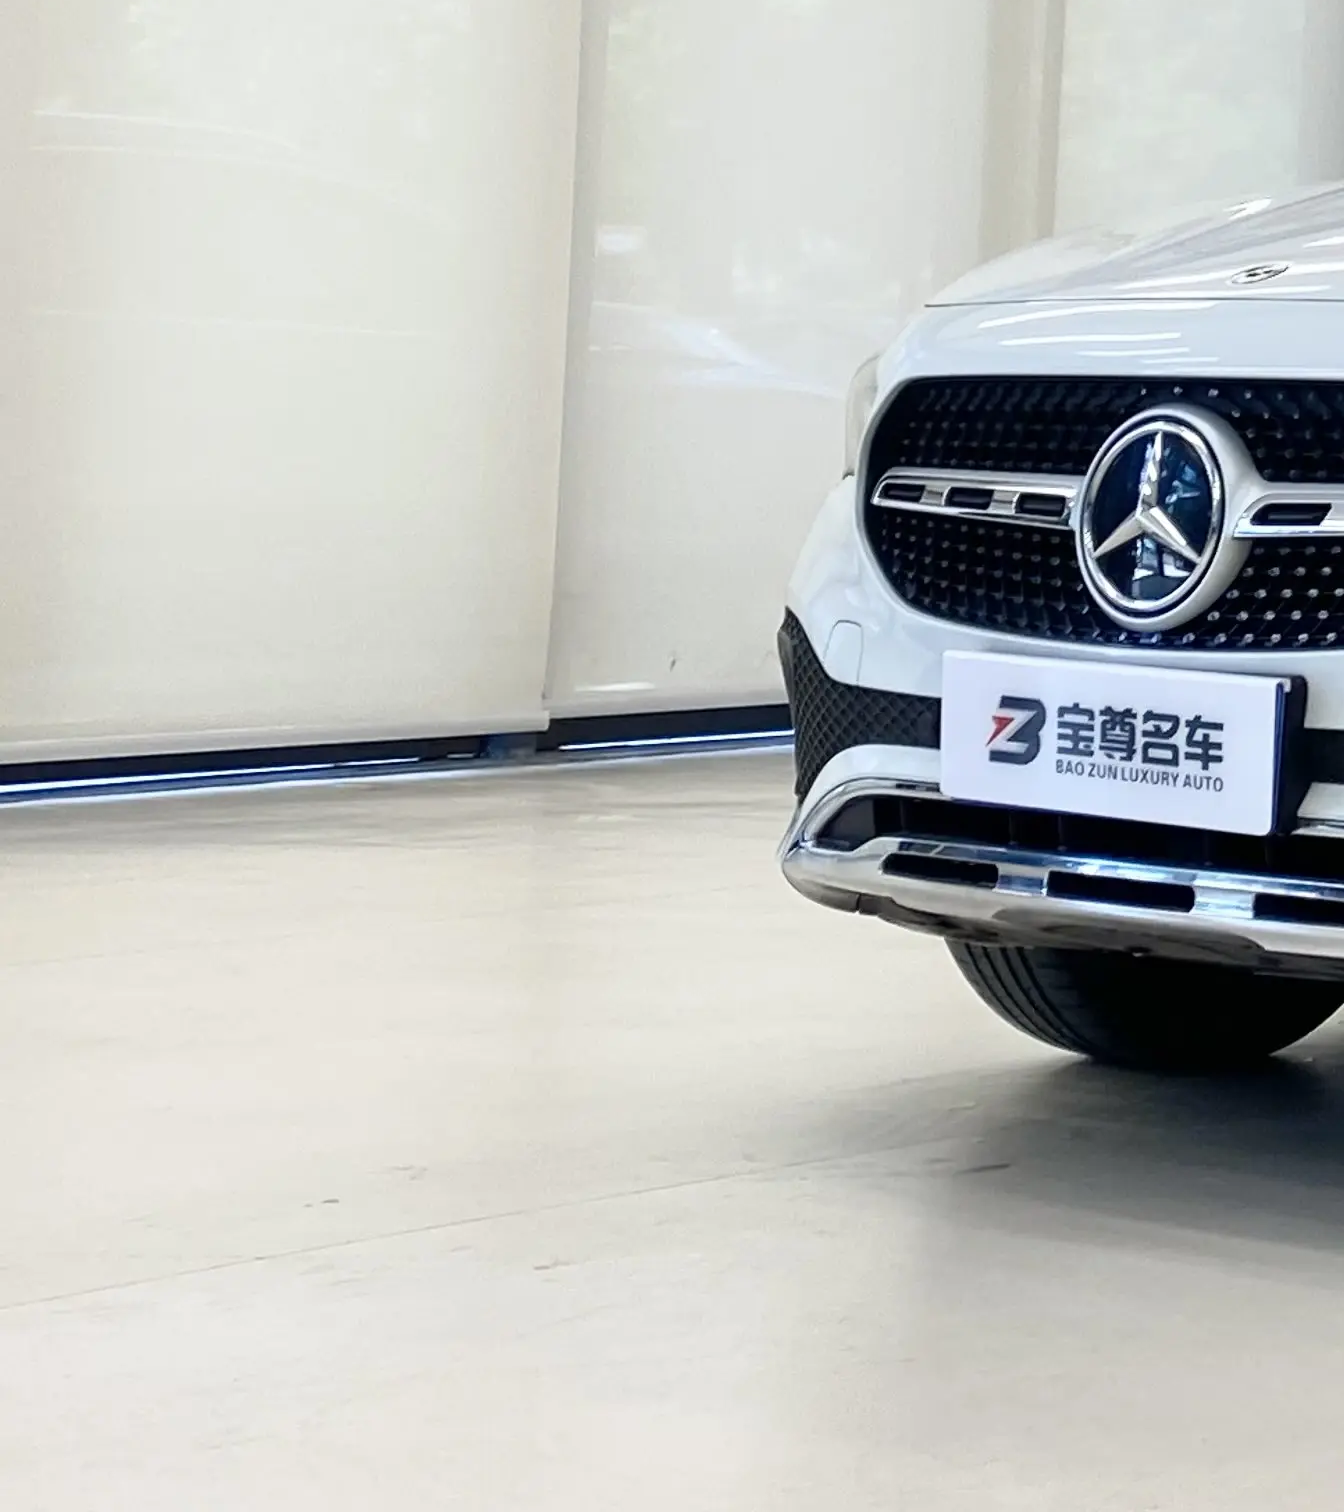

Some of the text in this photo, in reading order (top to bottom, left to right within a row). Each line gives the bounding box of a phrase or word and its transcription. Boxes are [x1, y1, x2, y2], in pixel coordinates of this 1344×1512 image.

[1056, 702, 1224, 771] 宝尊名车
[1056, 759, 1224, 792] BAO ZUN LUXURY AUTO
